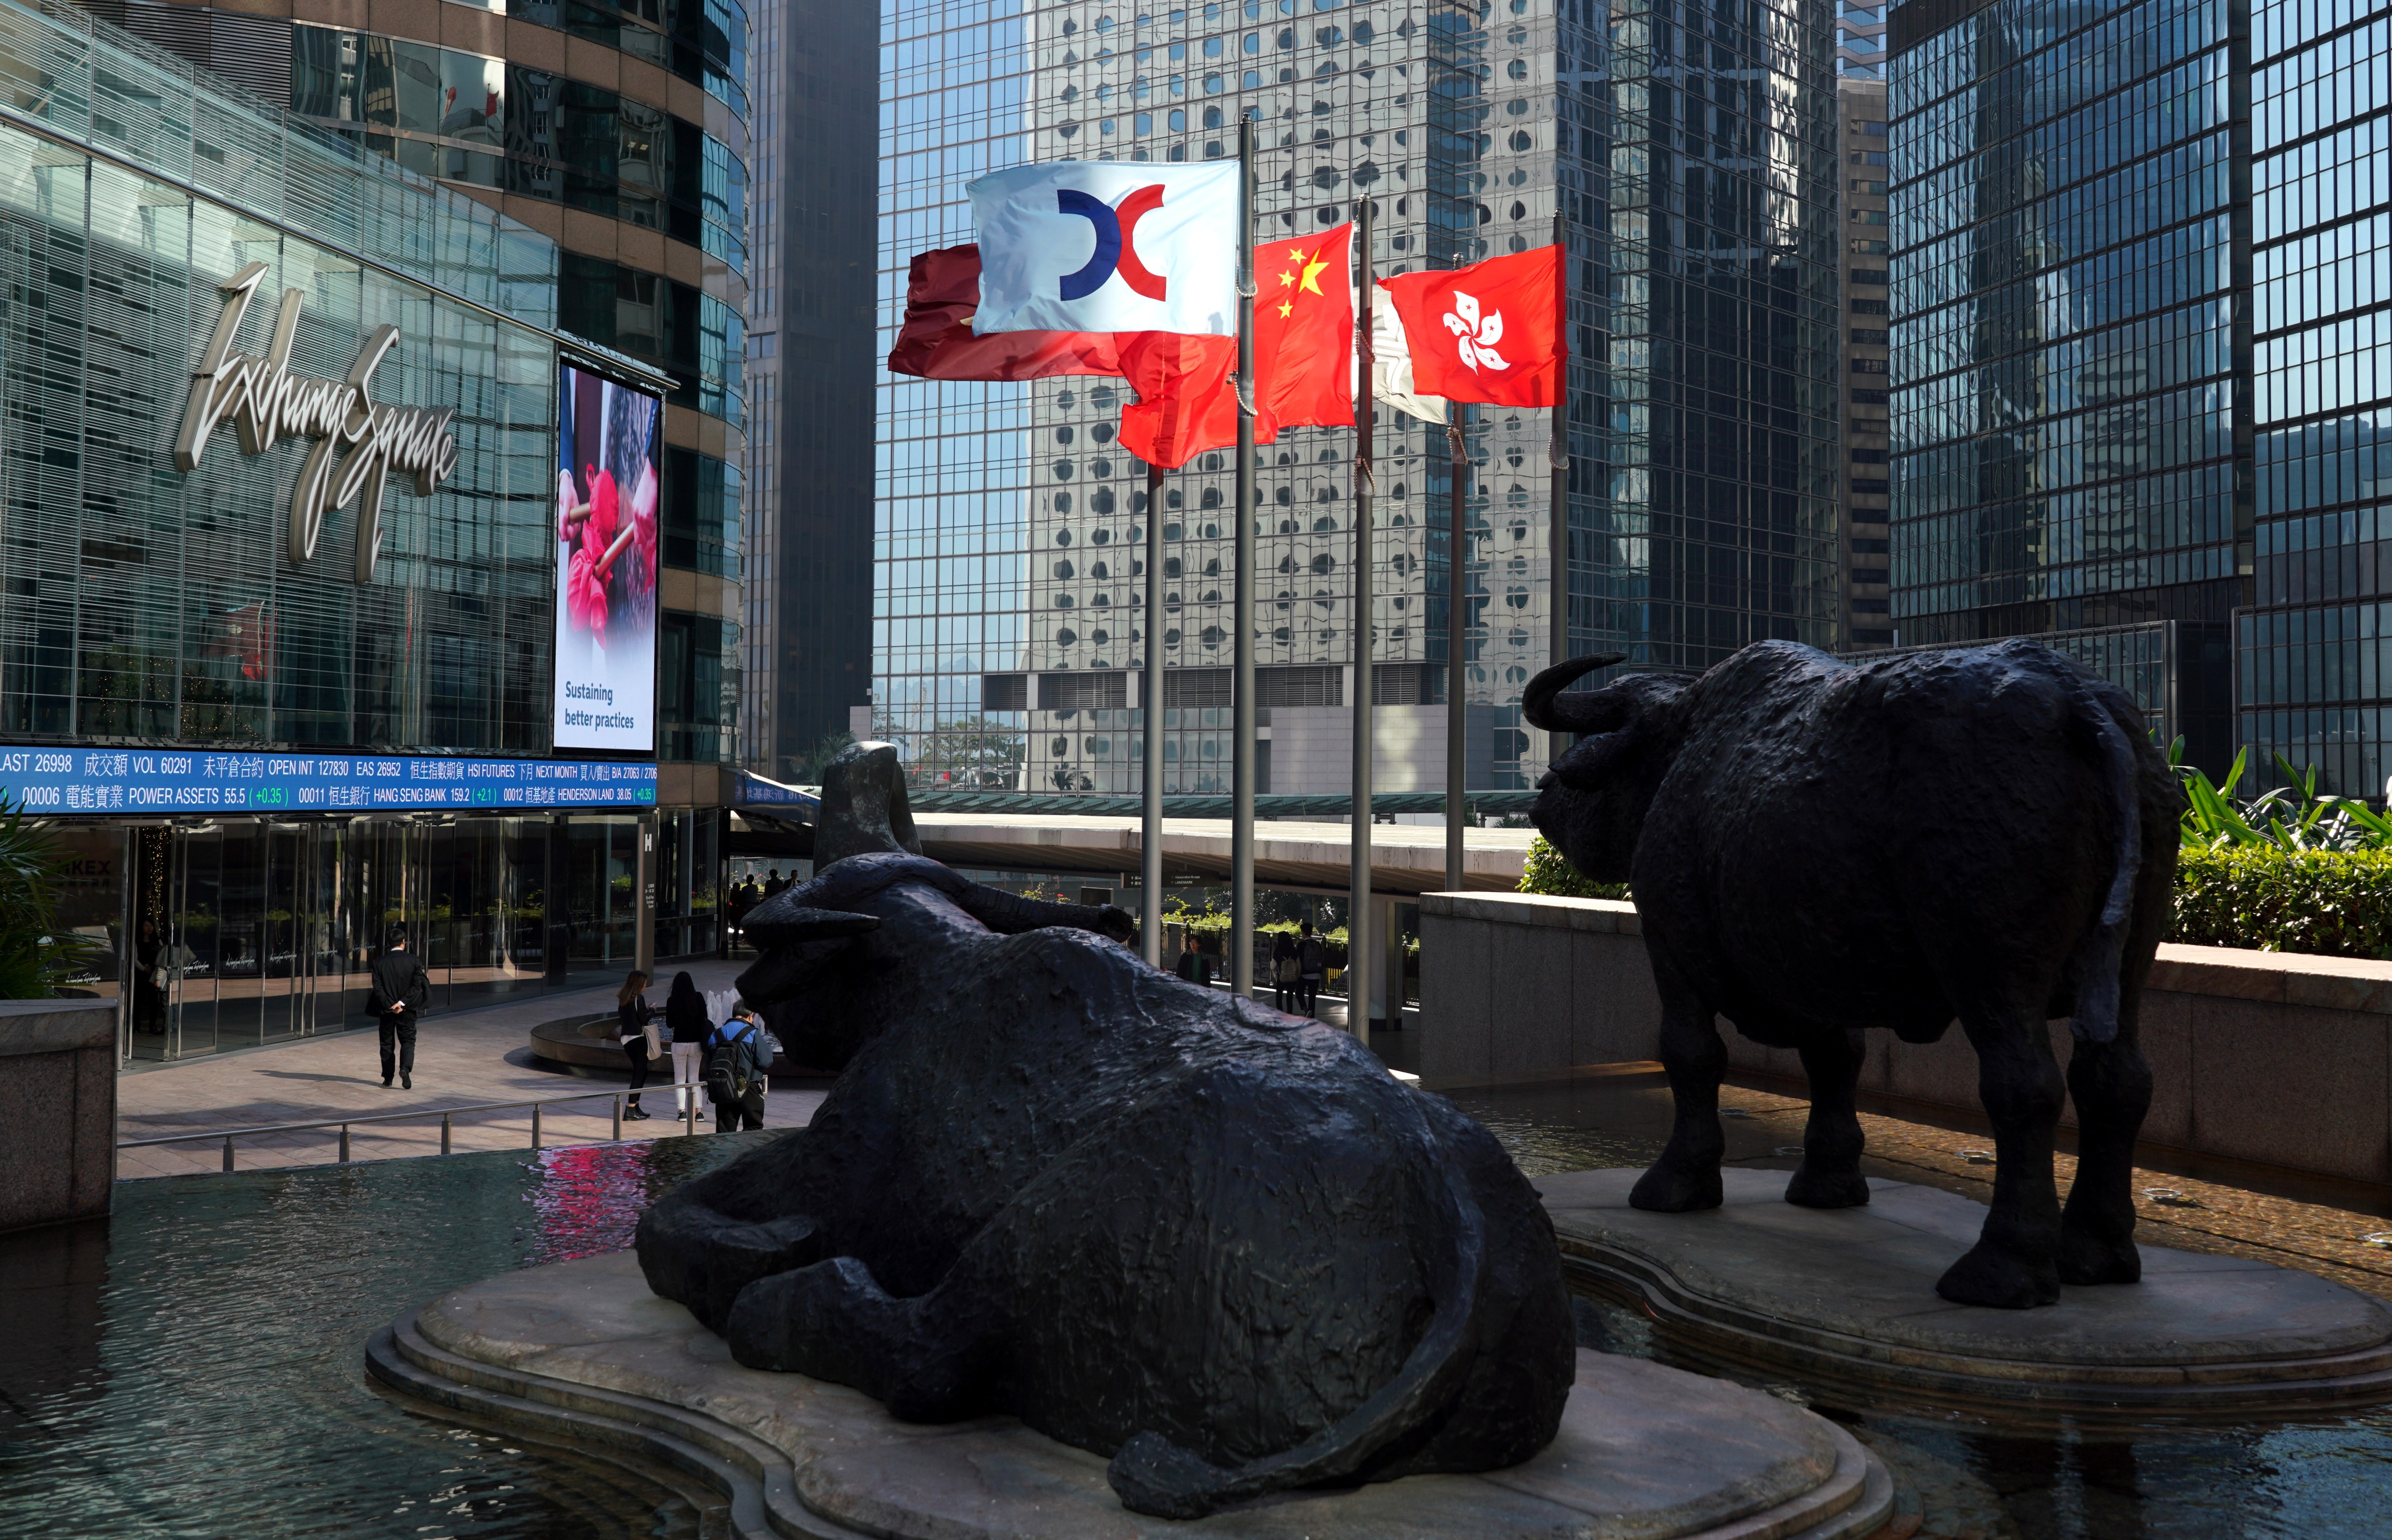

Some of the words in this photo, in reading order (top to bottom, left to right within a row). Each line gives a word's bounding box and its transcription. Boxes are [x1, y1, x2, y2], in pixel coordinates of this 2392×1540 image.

[174, 261, 369, 563] Exchange
[325, 323, 460, 584] Square
[566, 680, 613, 706] Sustaining
[565, 708, 593, 726] better
[595, 711, 634, 731] practices
[0, 754, 30, 771] AST
[35, 754, 72, 772] 26998
[85, 753, 128, 777] 成交額
[133, 756, 156, 773] VOL
[161, 757, 192, 774] 60291
[203, 756, 264, 778] 未平倉合約
[268, 759, 296, 775] OPEN
[299, 760, 314, 775] INT
[319, 761, 348, 776] 127830
[357, 762, 374, 776] EAS
[377, 762, 401, 777] 26952
[410, 761, 464, 780] 恒生指數期貨
[468, 764, 481, 777] HSI
[482, 764, 515, 778] FUTURES
[518, 763, 533, 780] 下月
[536, 765, 553, 778] NEXT
[554, 766, 577, 778] MONTH
[580, 764, 610, 781] 買入/賣出
[612, 767, 621, 779] B/A
[623, 767, 639, 779] 27063
[644, 768, 657, 779] 2706
[22, 787, 60, 805] 00006
[65, 784, 123, 809] 電能實業
[129, 787, 173, 804] POWER
[175, 788, 219, 804] ASSETS
[224, 788, 245, 804] 55.5
[299, 787, 324, 803] 00011
[329, 786, 370, 806] 恒生銀行
[374, 788, 398, 802] HANG
[400, 788, 423, 802] SENG
[425, 788, 447, 802] BANK
[451, 788, 469, 802] 159.2
[504, 788, 523, 802] 00012
[525, 786, 555, 804] 恒基地產
[558, 788, 597, 801] HENDERSON
[598, 788, 614, 801] LAND
[617, 788, 631, 801] 38.05
